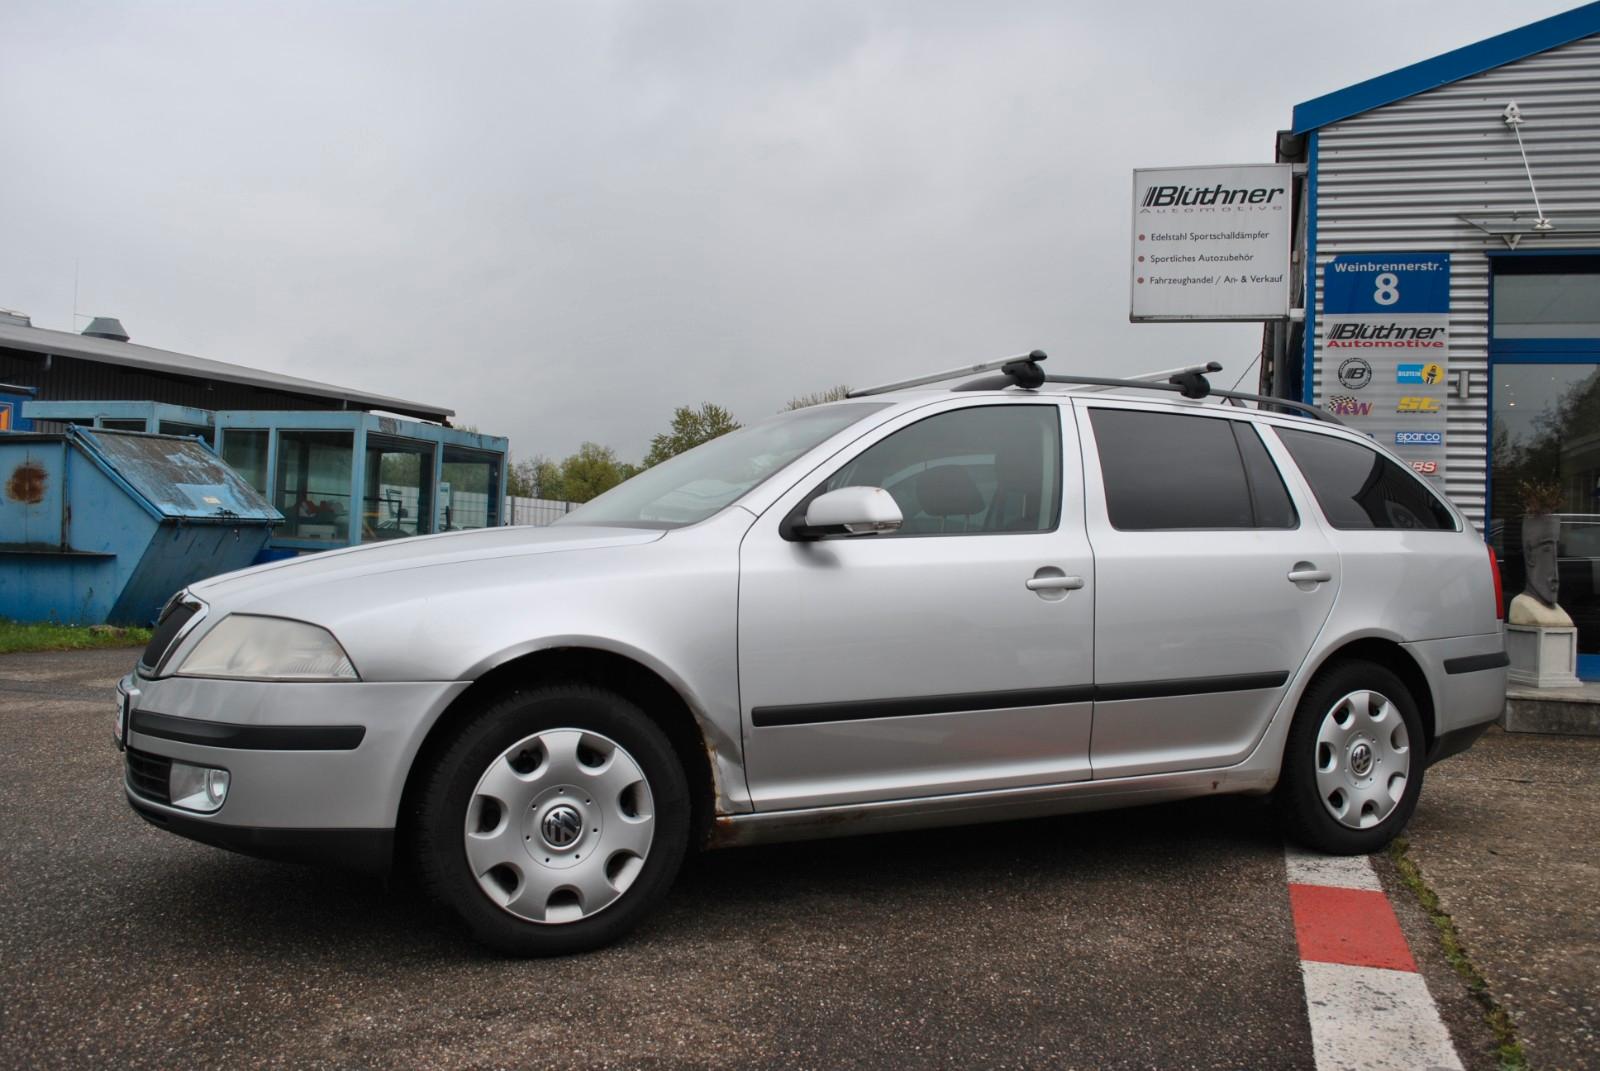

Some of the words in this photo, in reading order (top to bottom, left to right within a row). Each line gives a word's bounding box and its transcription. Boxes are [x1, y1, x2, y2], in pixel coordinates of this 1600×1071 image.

[1152, 184, 1284, 206] Blüthner
[1151, 233, 1187, 241] Edelstahl
[1189, 231, 1269, 241] Sportschalldämpfer
[1150, 254, 1196, 264] Sportliches
[1198, 254, 1254, 262] Autozubehör
[1334, 261, 1443, 272] Weinbrennerstr.
[1150, 275, 1214, 286] Fahrzeughandel
[1223, 275, 1238, 284] An-
[1240, 275, 1247, 283] &
[1250, 275, 1283, 283] Verkauf
[1373, 273, 1399, 305] 8
[1336, 323, 1445, 339] Blüthner
[1327, 340, 1445, 348] Automotive
[1396, 432, 1441, 444] sparco
